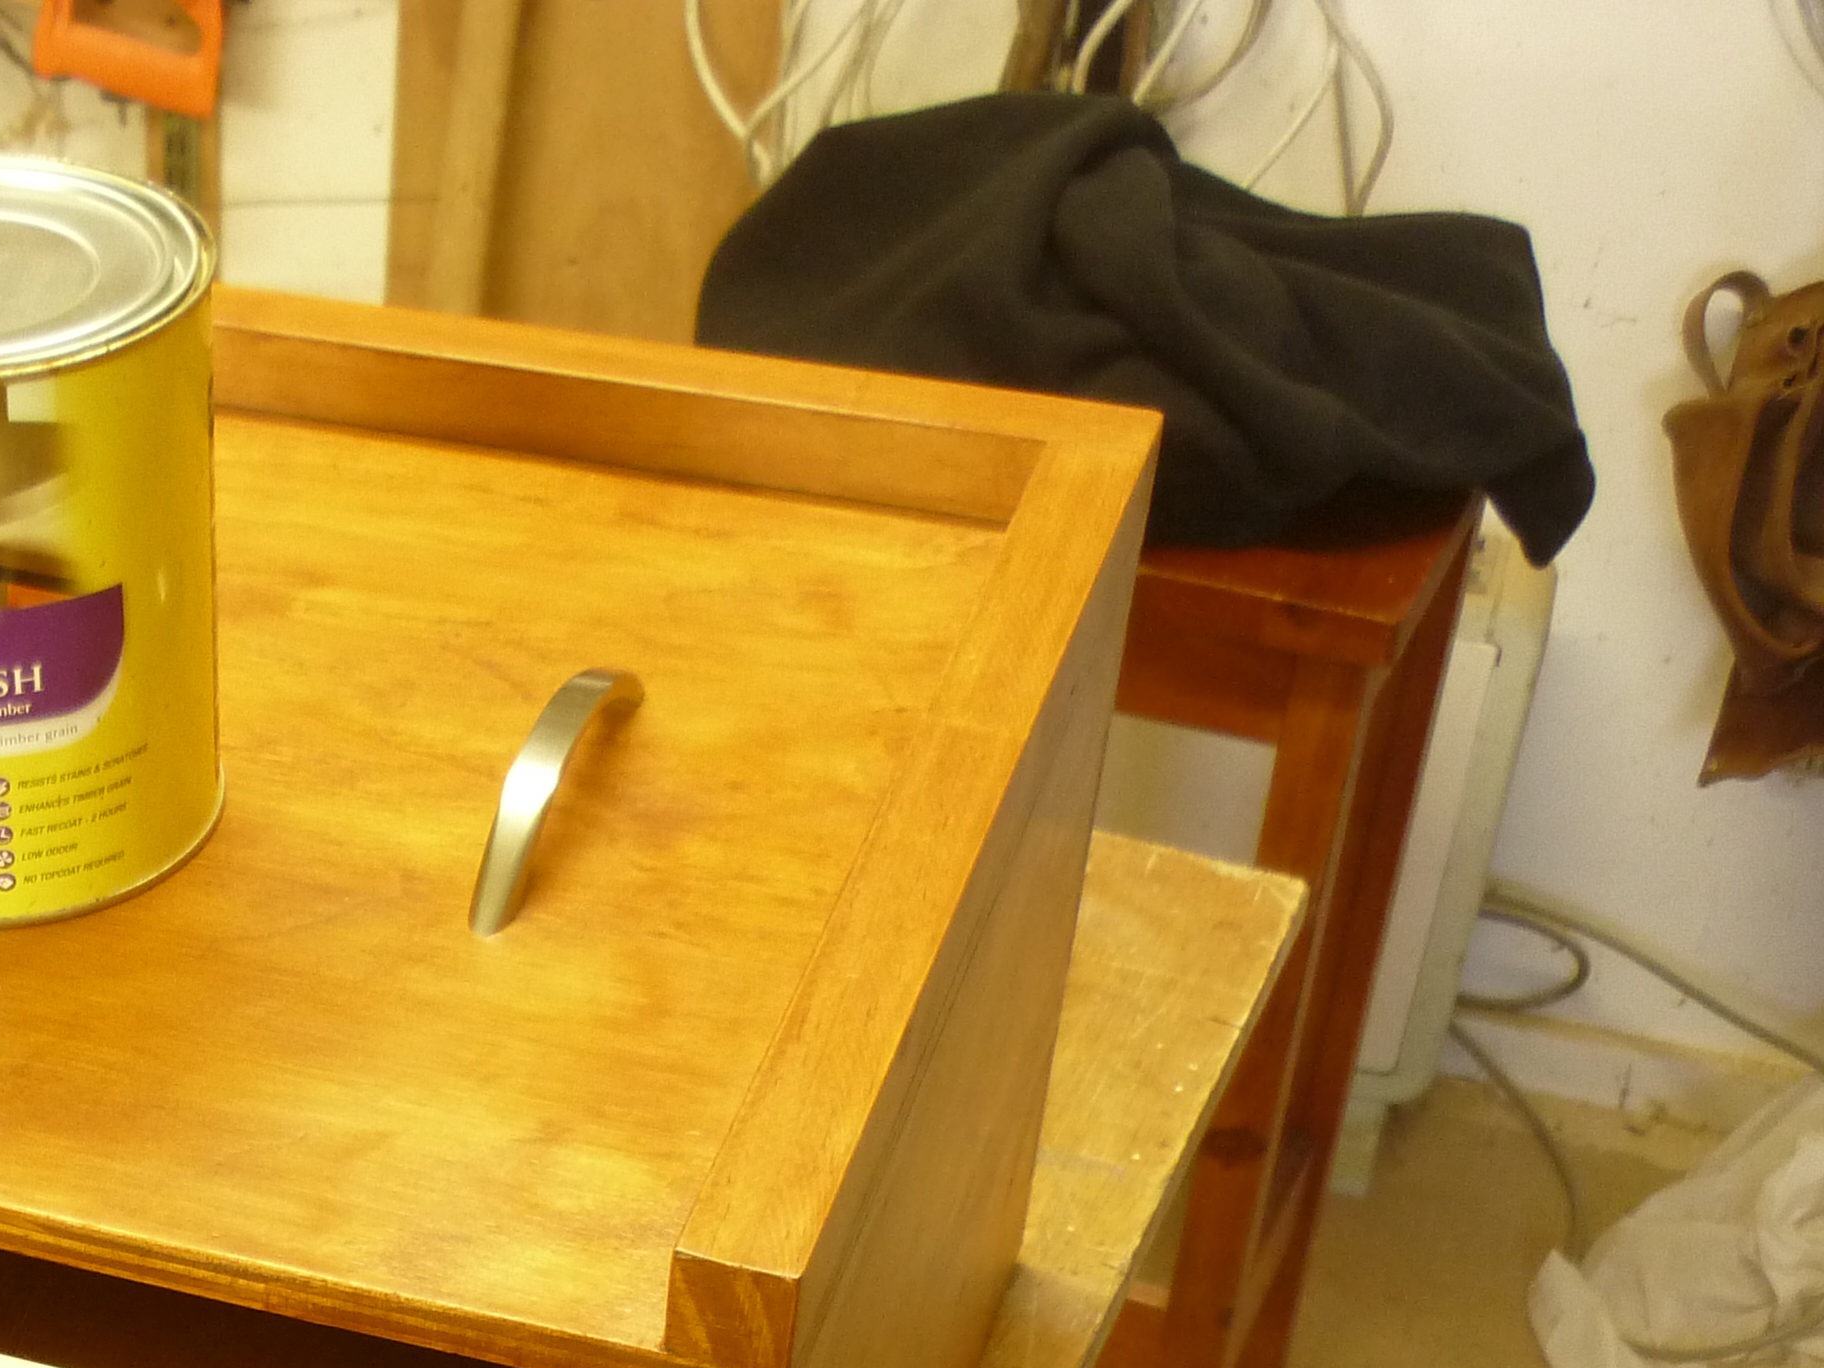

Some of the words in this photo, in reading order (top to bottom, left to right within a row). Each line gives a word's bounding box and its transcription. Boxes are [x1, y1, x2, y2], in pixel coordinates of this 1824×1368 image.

[44, 723, 79, 744] grain
[17, 773, 58, 790] RESISTS
[59, 766, 93, 784] STAINS
[20, 825, 46, 838] FAST
[46, 816, 84, 834] RECOAT
[21, 849, 43, 861] LOW
[23, 874, 38, 885] NO
[40, 864, 82, 881] TOPCOAT
